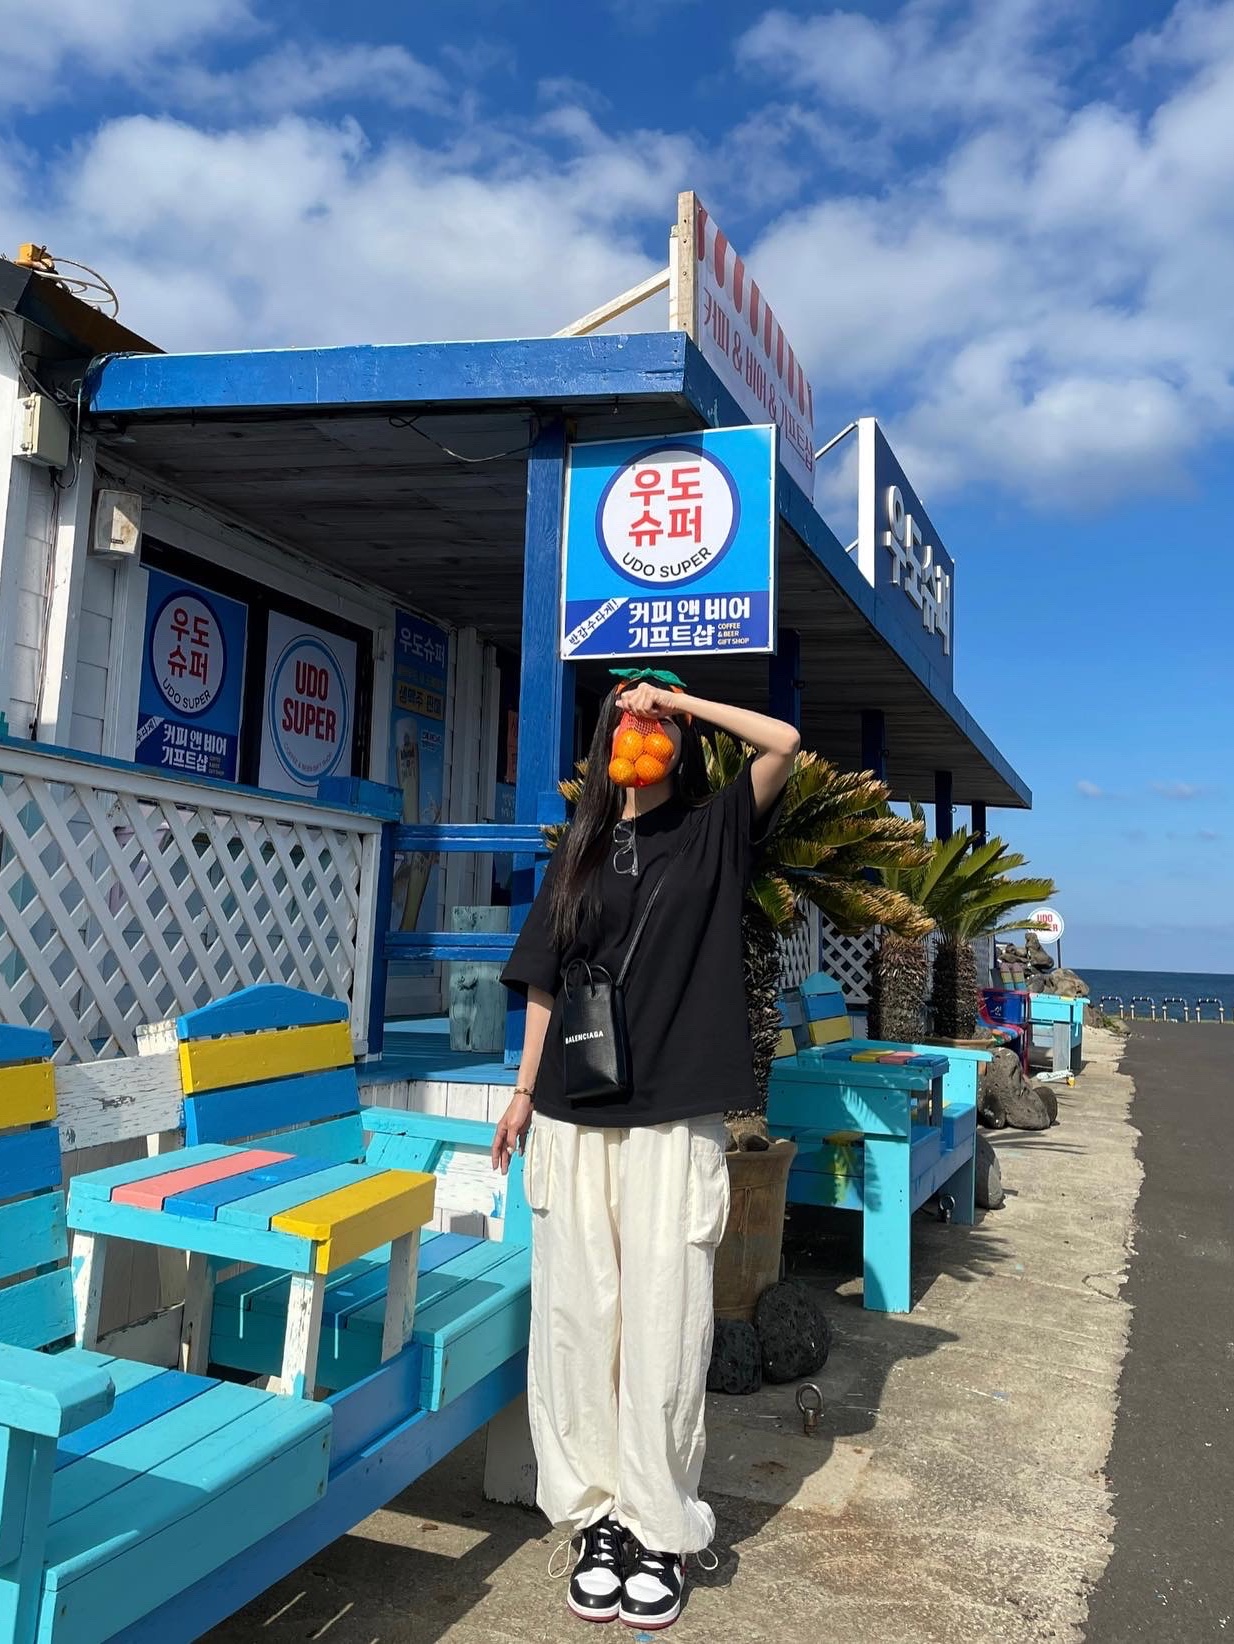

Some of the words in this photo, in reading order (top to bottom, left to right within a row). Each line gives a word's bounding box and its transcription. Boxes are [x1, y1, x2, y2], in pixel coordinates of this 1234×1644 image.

[704, 287, 729, 358] 커피
[732, 330, 743, 376] &
[745, 348, 766, 409] 비어
[769, 383, 777, 421] &
[630, 466, 703, 506] 우도
[628, 506, 702, 547] 슈퍼
[622, 552, 655, 577] UDO
[660, 547, 712, 578] SUPER
[884, 485, 950, 657] 우도슈퍼
[170, 607, 210, 648] 우도
[569, 599, 619, 645] 반갑수다게!
[628, 601, 673, 625] 커피
[677, 599, 700, 623] 앤
[705, 597, 750, 620] 비어
[400, 627, 445, 669] 우도슈퍼
[628, 624, 716, 648] 기프트샵
[723, 630, 740, 638] BEER
[732, 637, 750, 645] SHOP
[167, 645, 209, 685] 슈퍼
[295, 660, 329, 701] UDO
[162, 678, 181, 704] UDO
[183, 690, 211, 709] SUPER
[282, 698, 337, 743] SUPER
[163, 724, 188, 747] 커피
[190, 730, 203, 751] 앤
[203, 734, 227, 756] 비어
[161, 746, 209, 773] 기프트샵
[1036, 913, 1053, 923] UDO
[565, 1030, 604, 1045] BALENCIAGA
